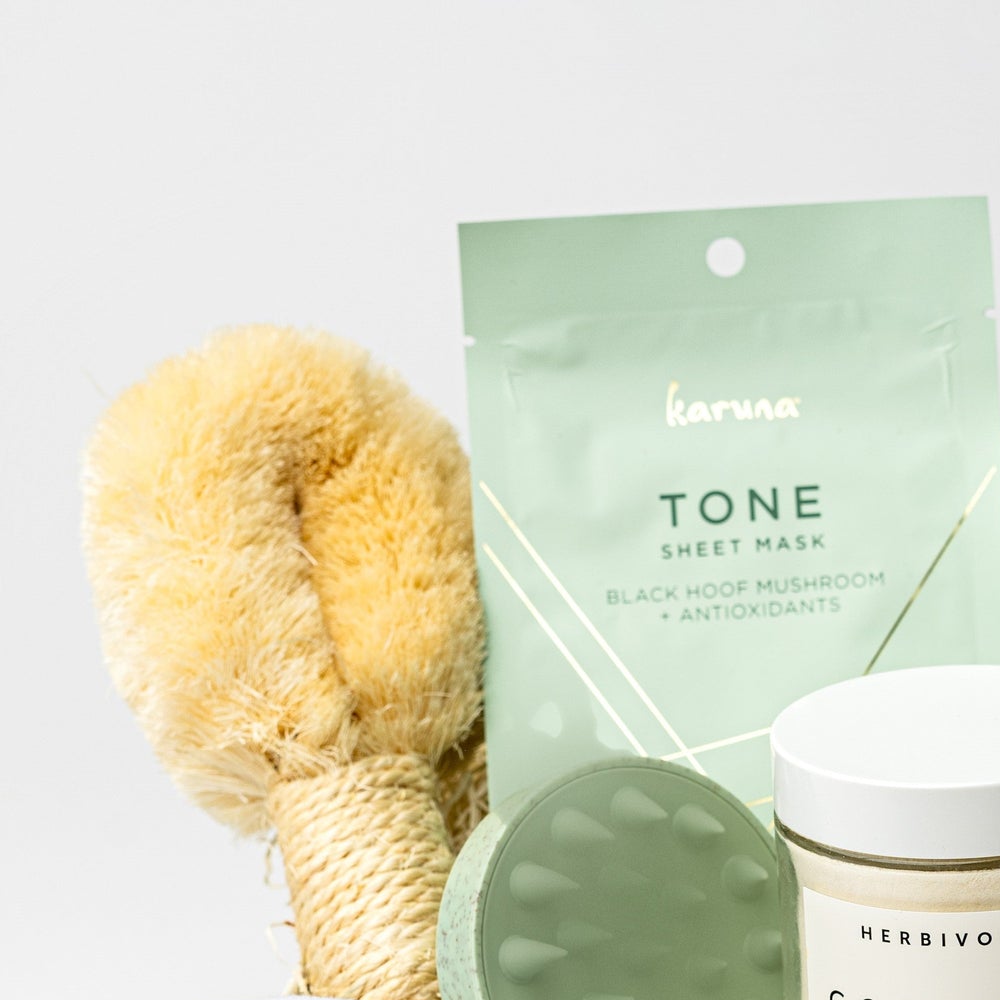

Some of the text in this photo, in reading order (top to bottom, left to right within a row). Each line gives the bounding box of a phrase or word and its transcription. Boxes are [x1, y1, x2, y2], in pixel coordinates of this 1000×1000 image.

[666, 380, 801, 427] karuna
[659, 485, 821, 527] TONE
[661, 534, 826, 560] SHEET MASK
[606, 572, 886, 605] BLACK HOOF MUSHROOM
[679, 596, 841, 622] ANTIOXIDANTS
